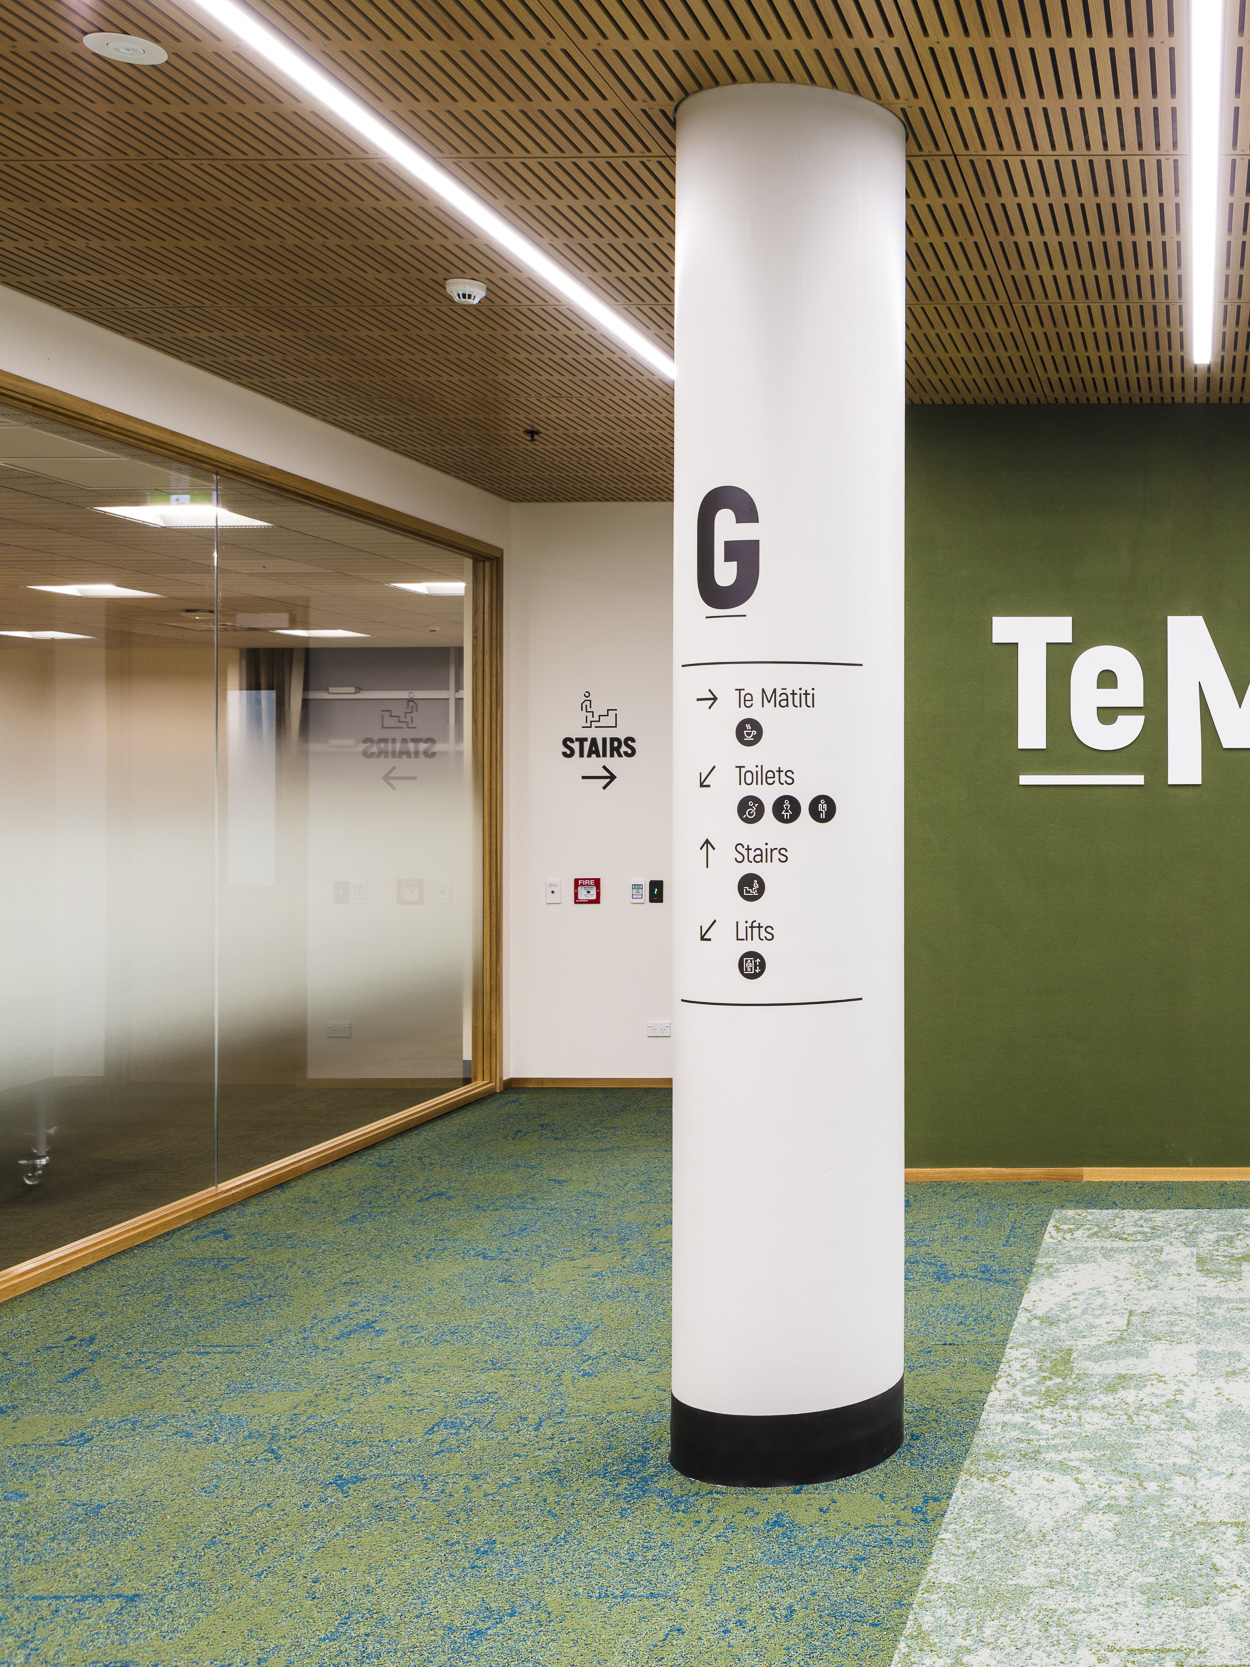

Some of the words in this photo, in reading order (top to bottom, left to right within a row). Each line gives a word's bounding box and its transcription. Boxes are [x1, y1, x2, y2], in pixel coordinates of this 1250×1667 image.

[697, 485, 760, 610] G
[992, 616, 1145, 750] Te
[735, 689, 754, 709] Te
[762, 687, 816, 709] Mātiti
[562, 737, 637, 758] STAIRS
[735, 765, 795, 786] Toilets
[735, 843, 789, 864] Stairs
[735, 920, 775, 942] Lifts
